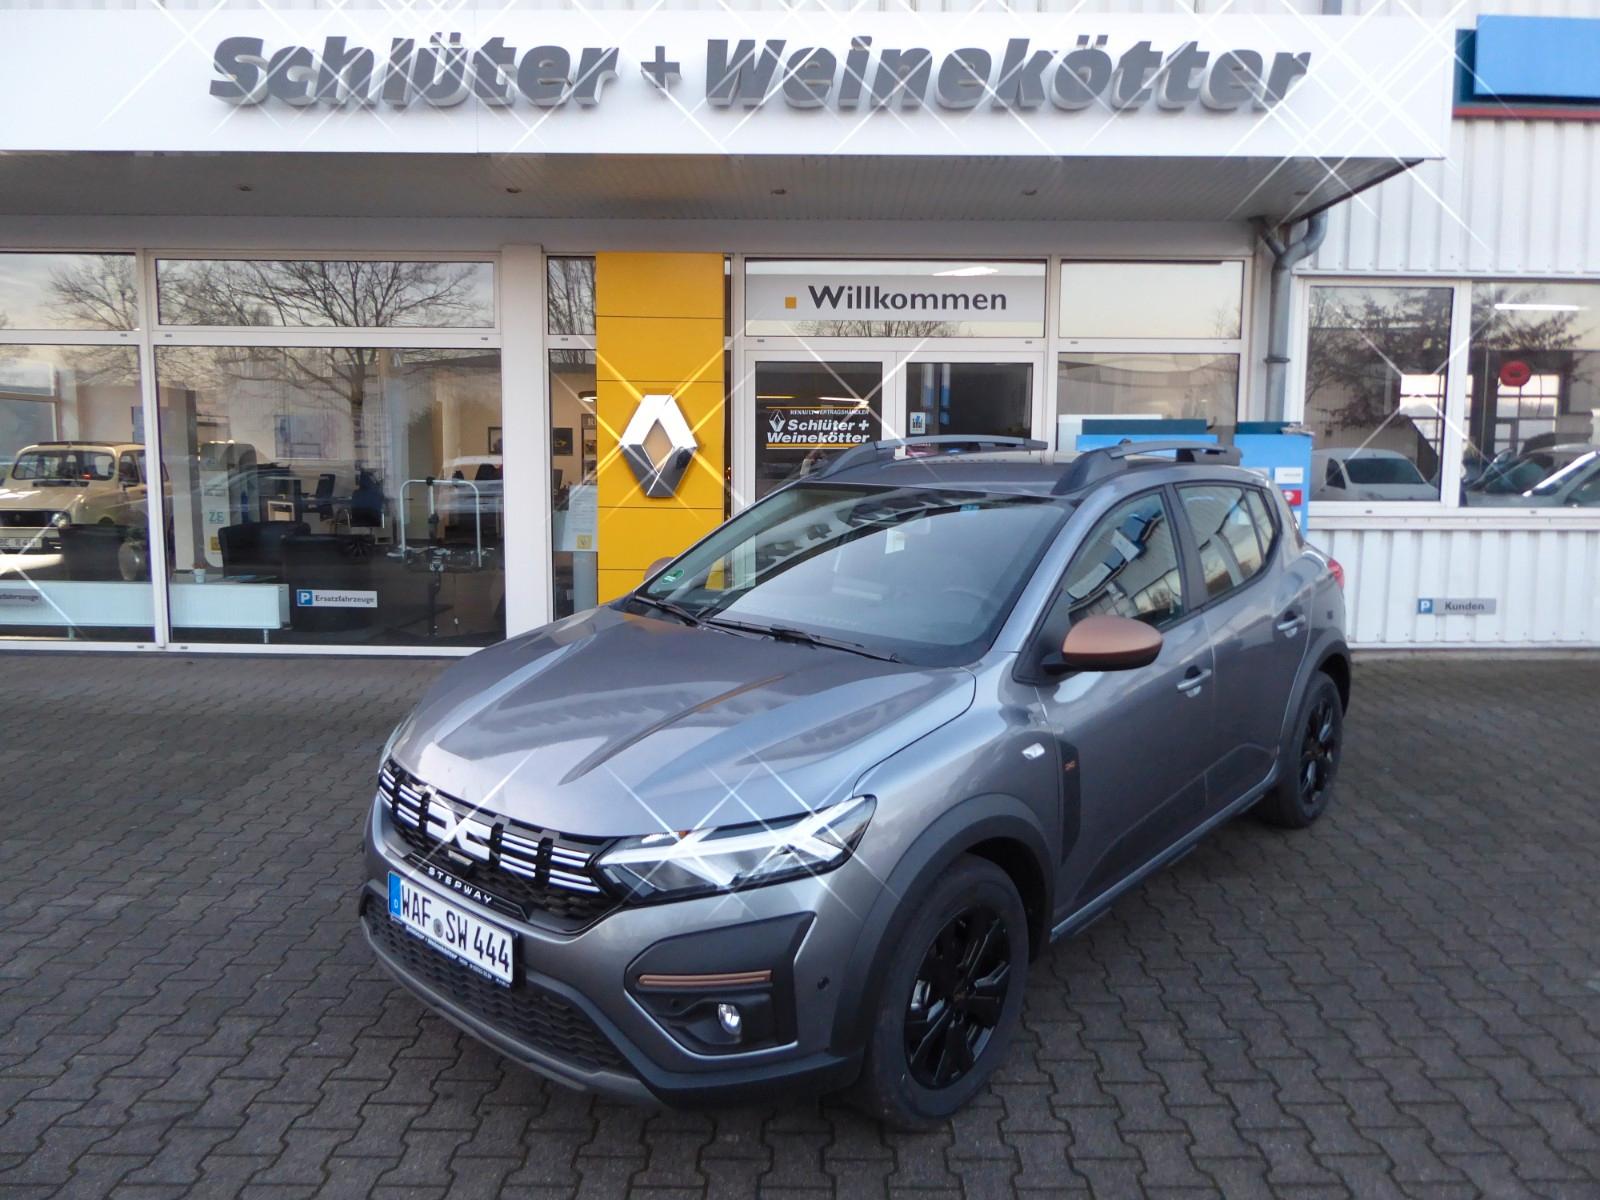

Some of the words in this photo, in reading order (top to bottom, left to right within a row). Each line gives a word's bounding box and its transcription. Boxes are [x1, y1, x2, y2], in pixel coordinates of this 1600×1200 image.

[209, 33, 620, 106] Schlüter
[640, 45, 683, 89] +
[705, 34, 1313, 108] Weinekötter
[808, 285, 1007, 310] Willkommen
[787, 419, 855, 431] Schlüter
[858, 420, 869, 431] +
[767, 432, 870, 443] Weinekötter
[315, 595, 375, 604] Ersatzfahrzeuge
[1445, 601, 1485, 611] Kunden
[429, 867, 491, 903] STEPWAY
[402, 885, 432, 927] WAF
[446, 909, 468, 951] SW
[474, 925, 510, 973] 444
